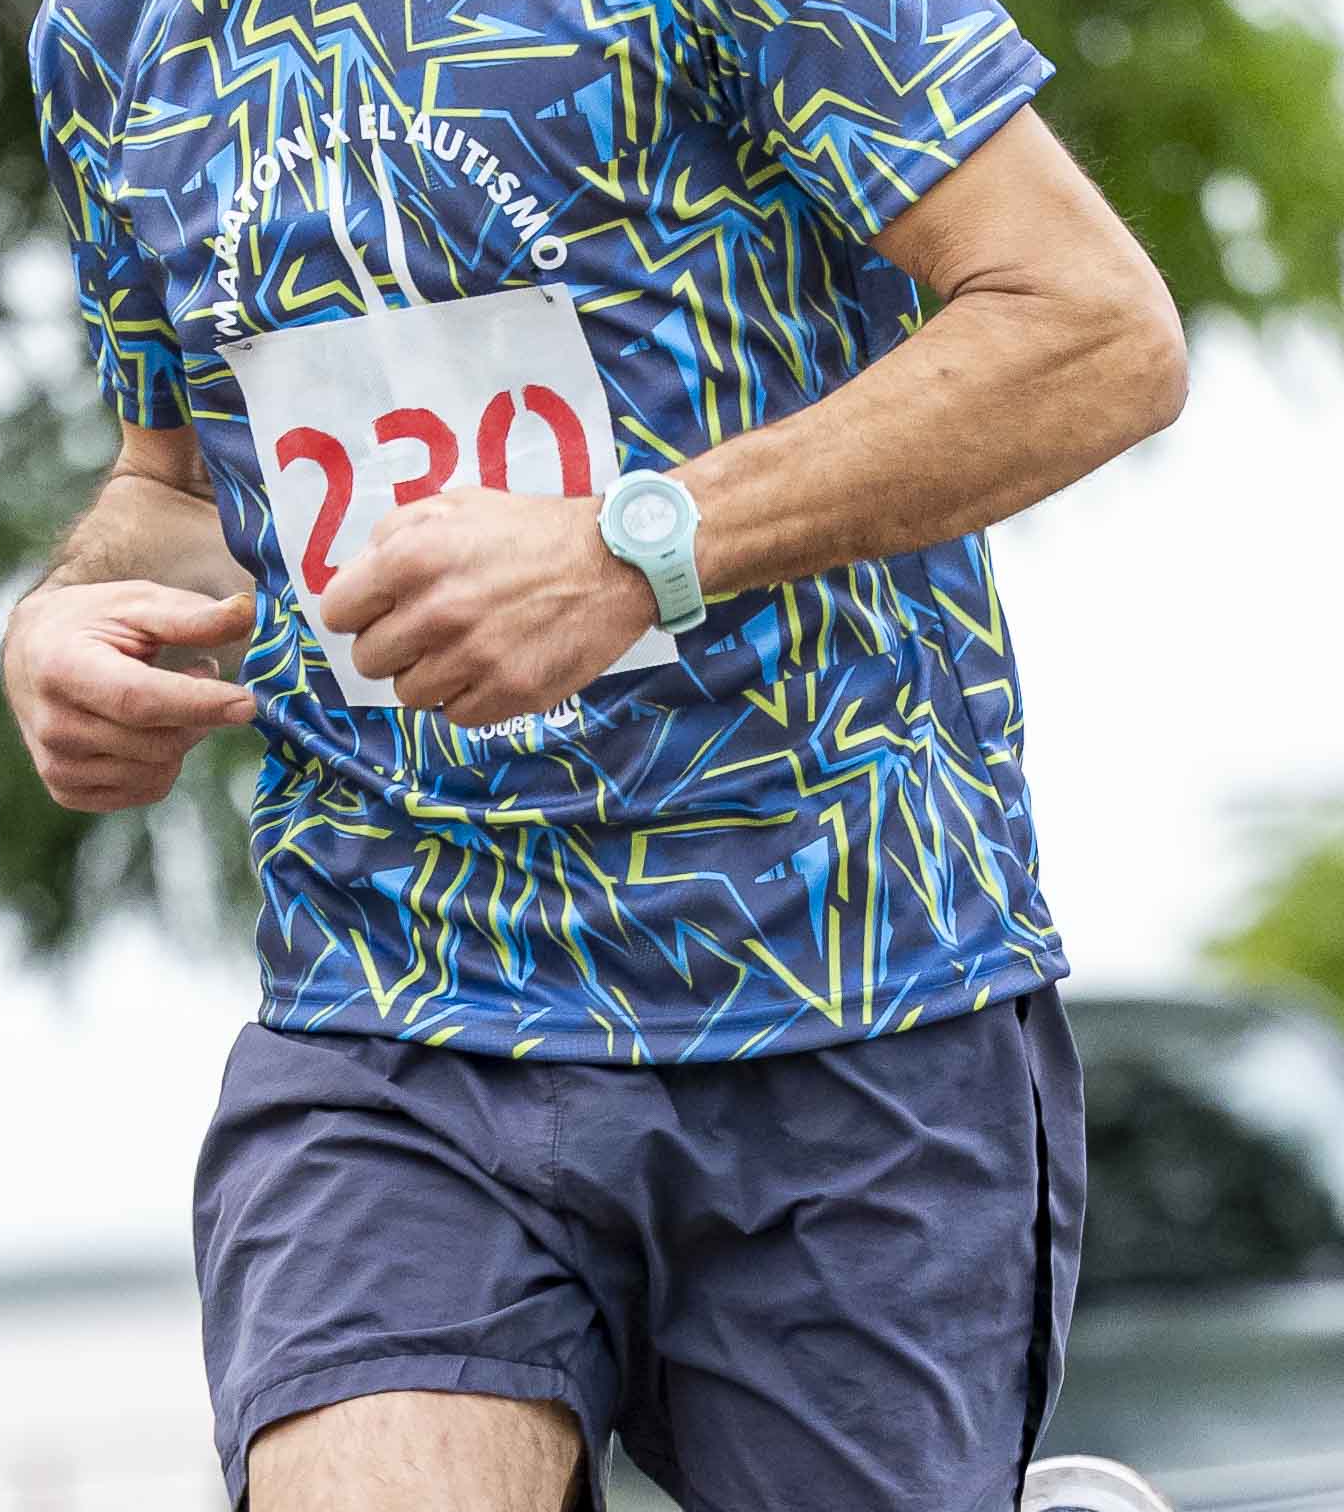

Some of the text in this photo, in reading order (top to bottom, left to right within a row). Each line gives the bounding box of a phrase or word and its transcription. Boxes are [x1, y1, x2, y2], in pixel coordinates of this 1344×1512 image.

[320, 108, 350, 148] X
[359, 104, 396, 141] EL
[405, 112, 567, 271] AUTISMO
[275, 384, 592, 595] 230
